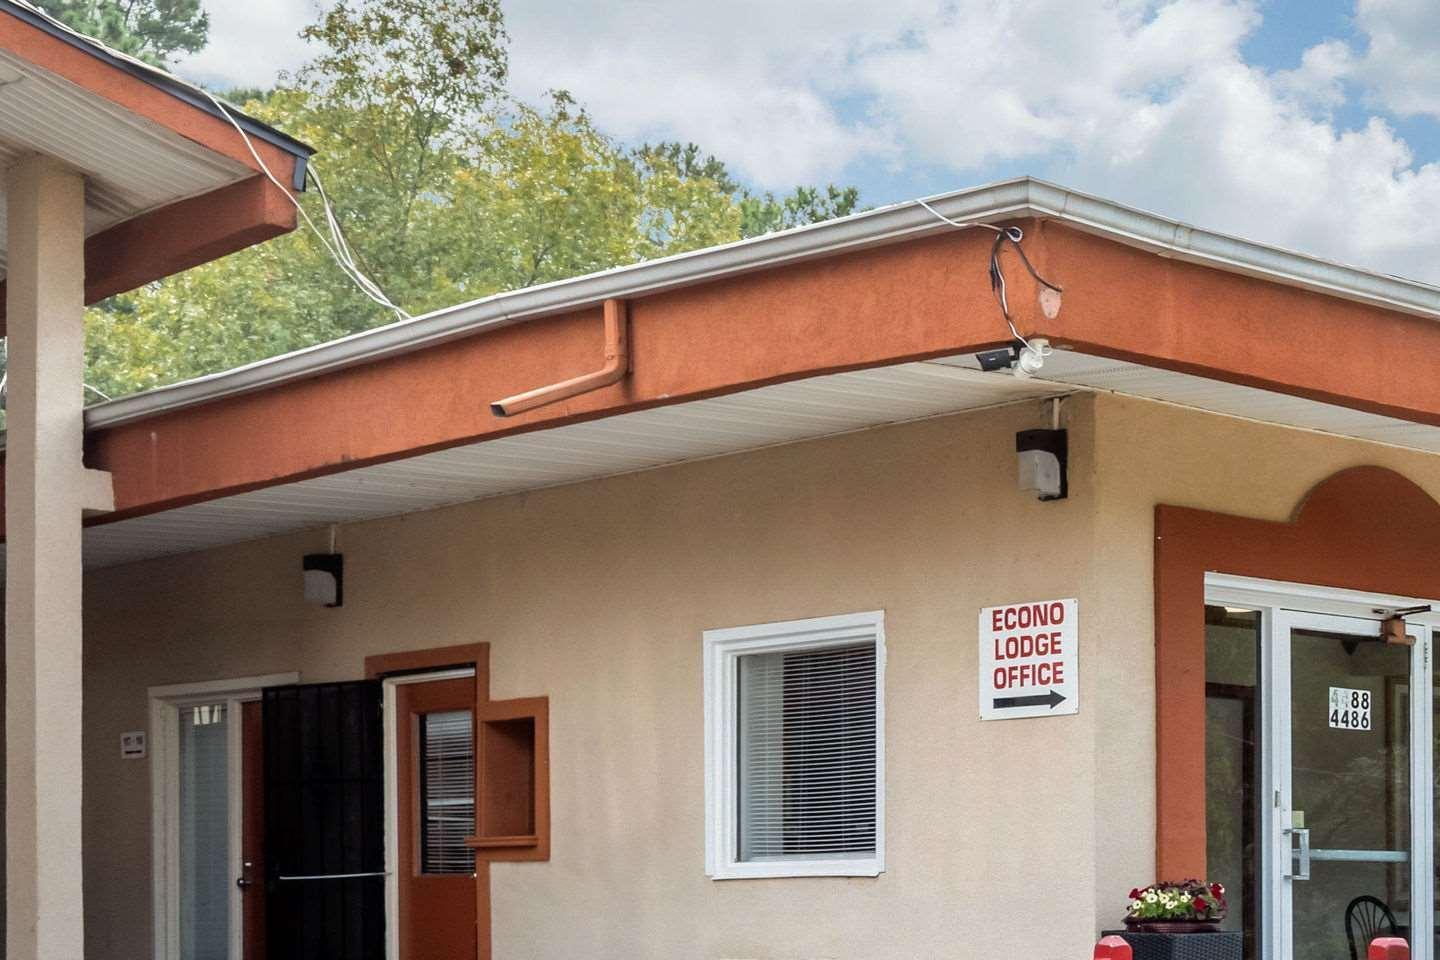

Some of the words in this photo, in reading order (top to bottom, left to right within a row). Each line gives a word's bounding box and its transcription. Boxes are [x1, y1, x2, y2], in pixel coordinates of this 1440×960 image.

[992, 602, 1064, 632] ECONO
[994, 632, 1062, 660] LODGE
[993, 662, 1064, 689] OFFICE
[1330, 709, 1369, 728] 4486
